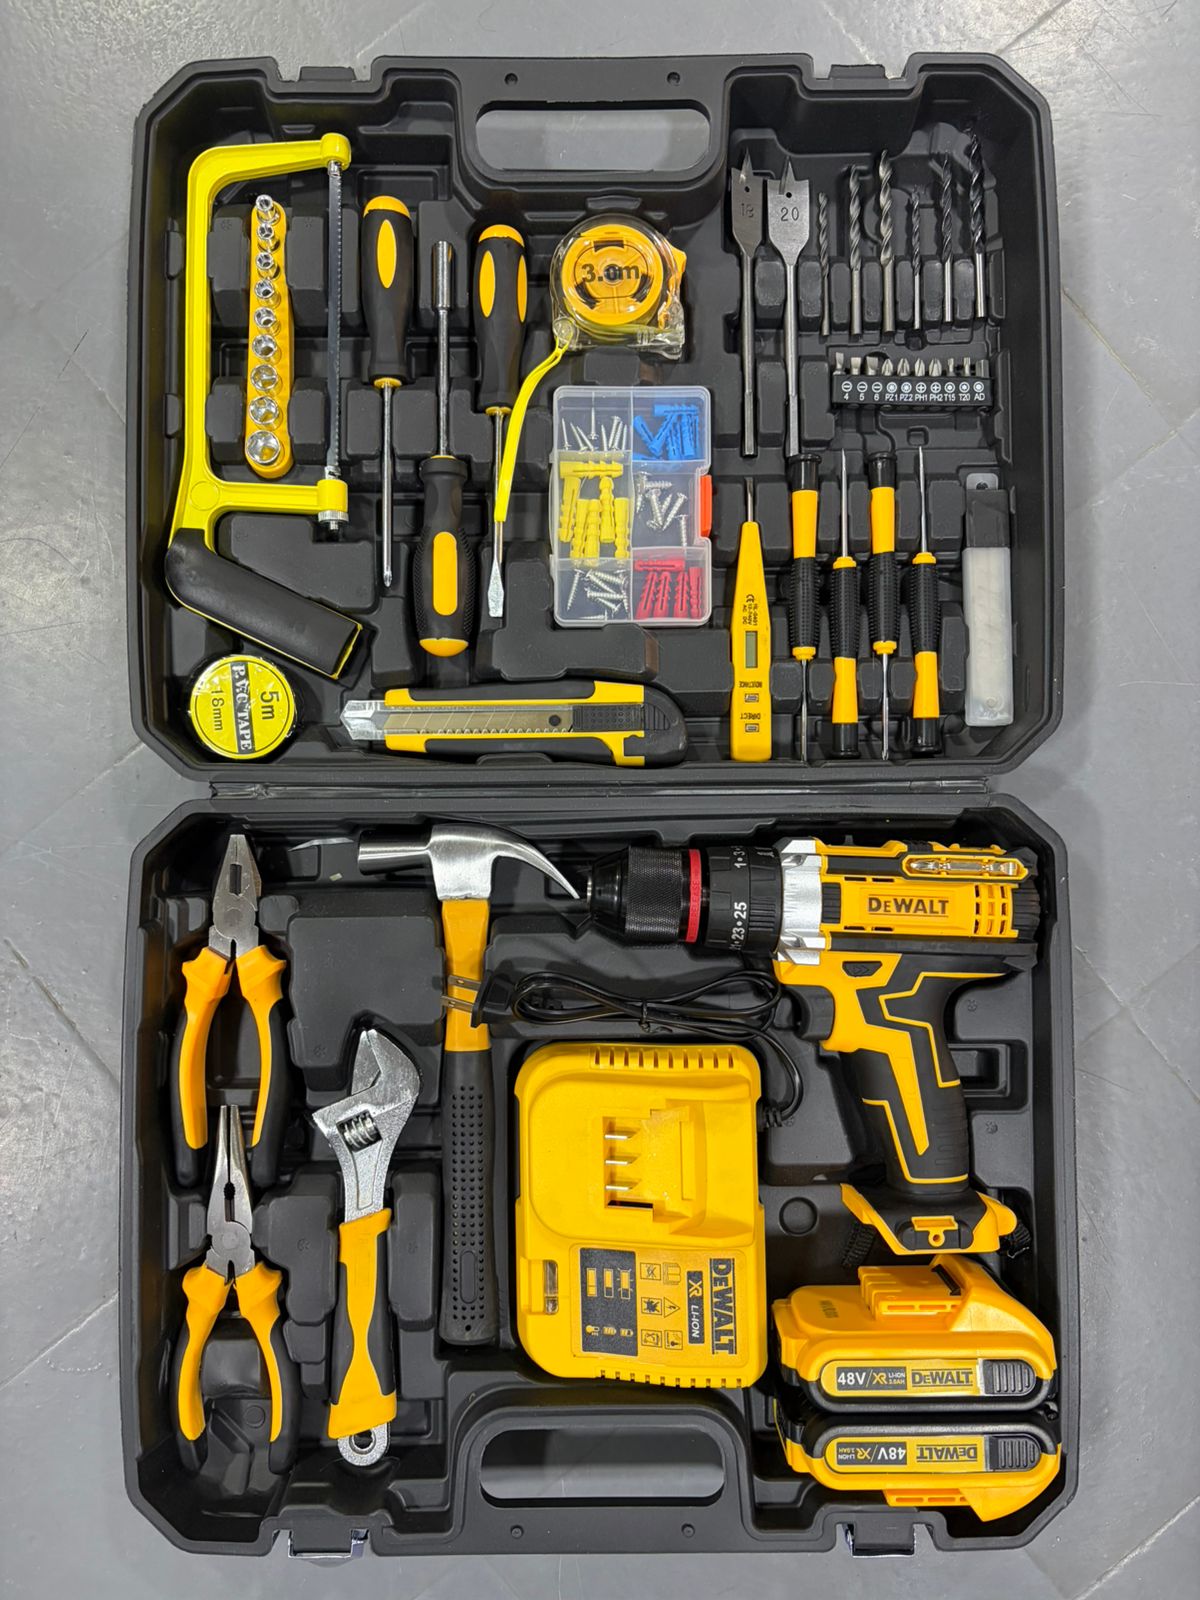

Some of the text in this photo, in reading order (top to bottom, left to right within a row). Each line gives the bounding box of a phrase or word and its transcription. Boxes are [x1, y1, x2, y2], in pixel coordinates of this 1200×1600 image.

[780, 206, 800, 222] 20
[843, 392, 985, 401] 4 5 6 PZ1 PZ2 PH1 PH2 T15 T20 AD
[211, 690, 225, 731] 18mm
[260, 690, 280, 720] 5m
[740, 712, 761, 720] DIRECT
[237, 705, 252, 751] TAPE
[733, 901, 748, 920] 25
[731, 927, 745, 941] 23
[688, 1279, 703, 1338] XR LI-ION
[711, 1258, 734, 1354] DEWALT
[837, 1371, 888, 1386] 48V XR
[856, 1446, 907, 1460] 48V XR
